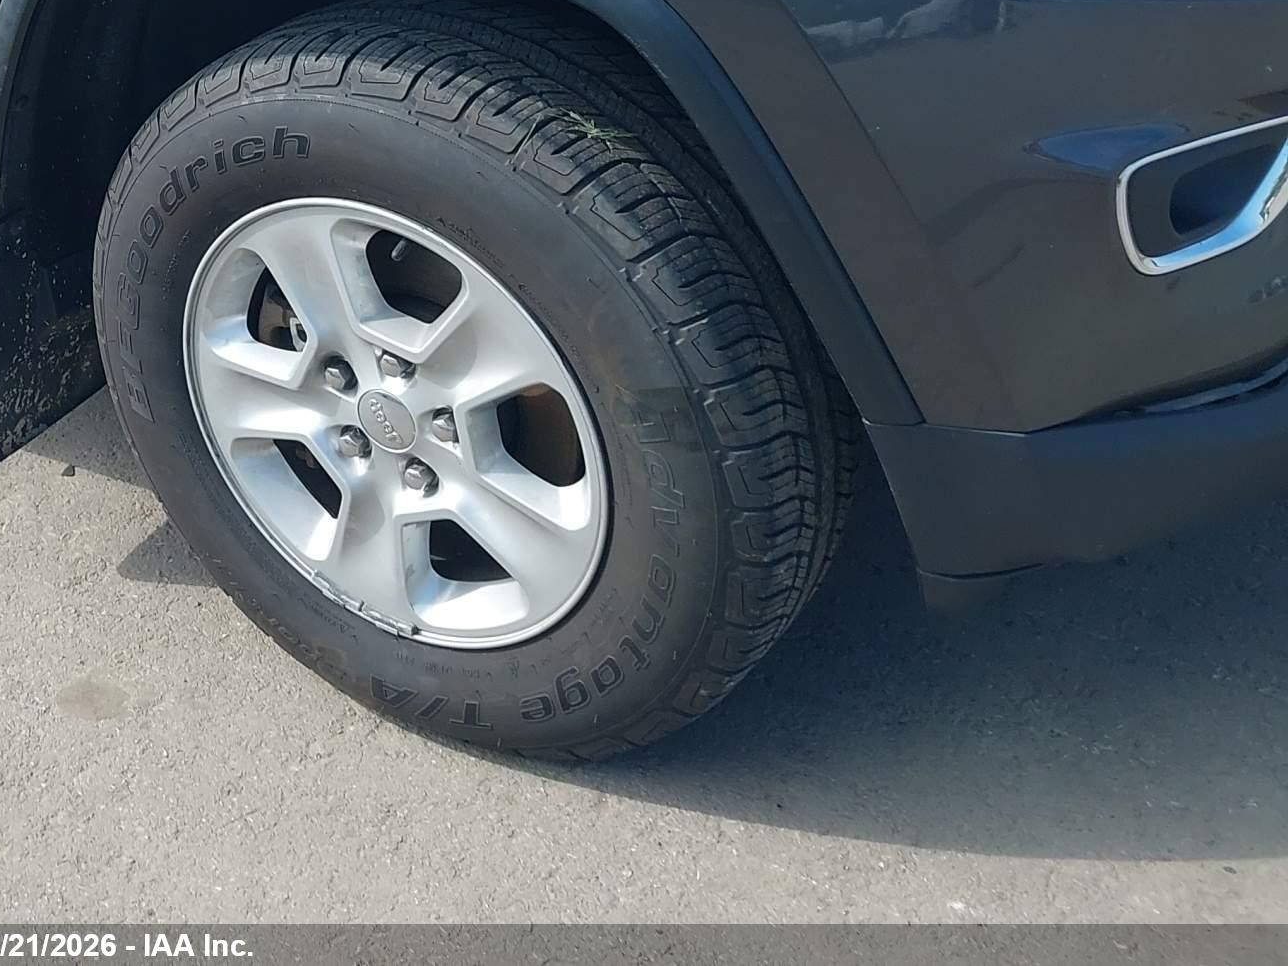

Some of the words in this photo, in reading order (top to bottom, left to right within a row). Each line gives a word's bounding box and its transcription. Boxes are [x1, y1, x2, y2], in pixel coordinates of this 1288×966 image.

[117, 125, 311, 423] BFGoodrich
[369, 398, 404, 444] Jeep
[369, 674, 494, 731] T/A
